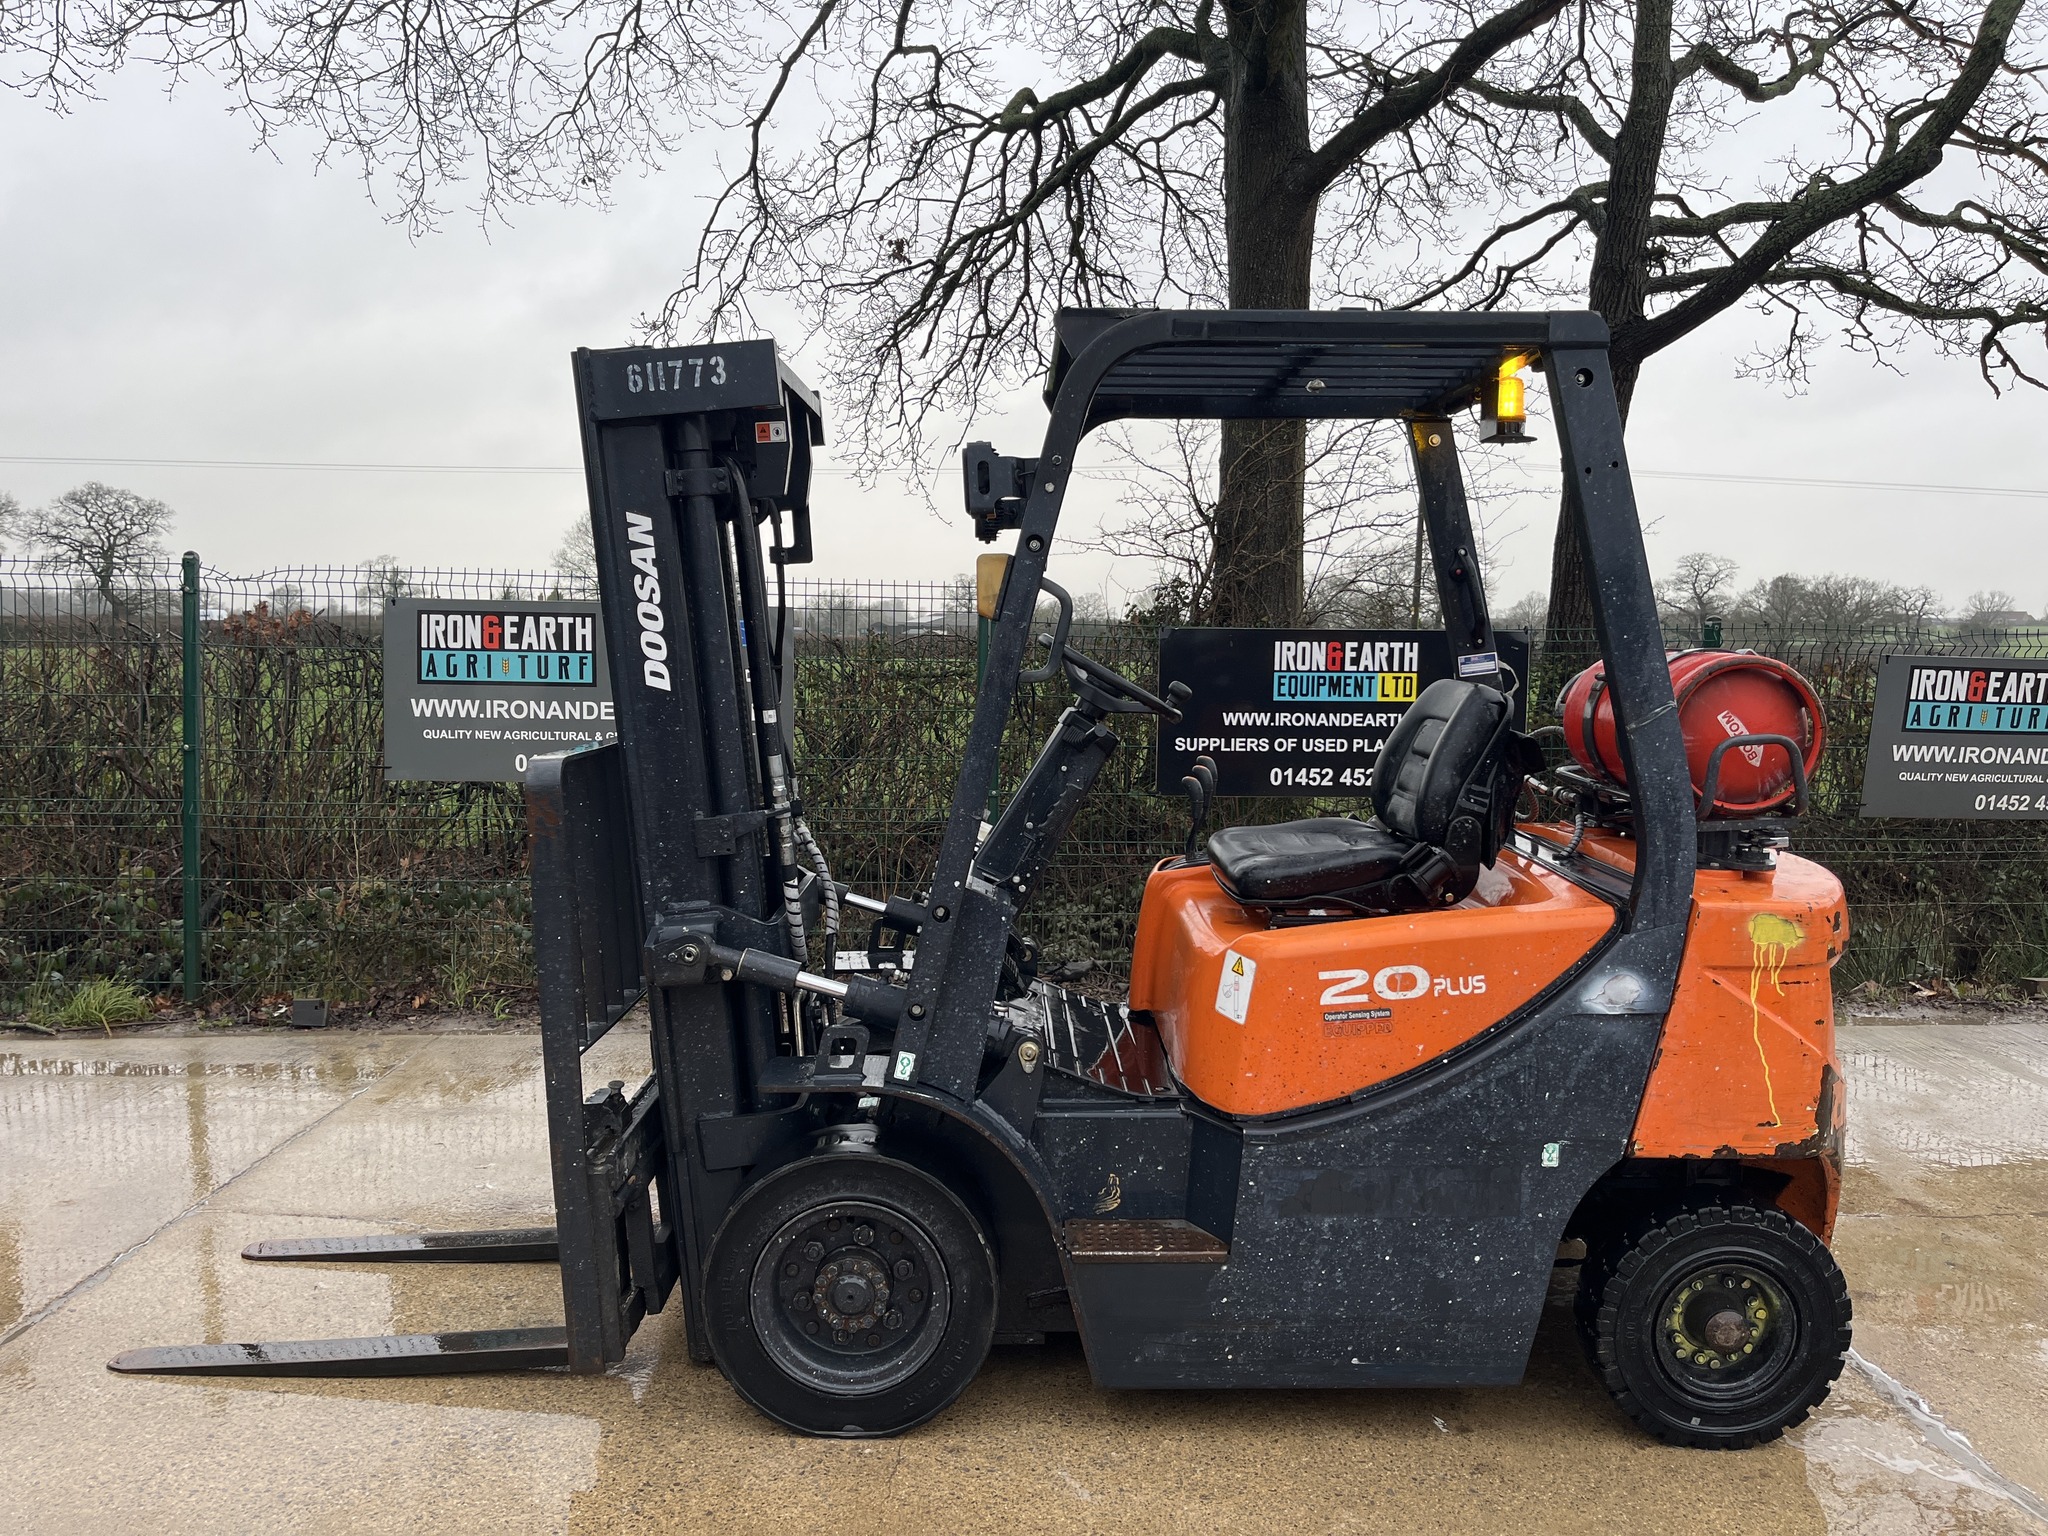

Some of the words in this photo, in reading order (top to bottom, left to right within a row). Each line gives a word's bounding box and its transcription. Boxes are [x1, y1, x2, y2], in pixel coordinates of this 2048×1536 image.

[626, 356, 726, 393] 611773
[626, 511, 671, 692] DOOSAN
[425, 654, 492, 678] AGRI
[517, 655, 588, 680] TURF
[1276, 675, 1375, 699] EQUIPMENT
[1380, 676, 1413, 698] LTD
[1910, 669, 2048, 703] IRON&EART
[410, 698, 615, 720] WWW.IRONANDE
[1909, 704, 1974, 728] AGRI
[1995, 707, 2048, 730] TUR
[423, 729, 473, 740] QUALITY
[475, 730, 502, 740] NEW
[503, 731, 592, 741] AGRICULTURAL
[594, 732, 603, 741] &
[1174, 738, 1270, 752] SUPPLIERS
[1273, 738, 1298, 752] OF
[1301, 738, 1348, 753] USED
[1269, 767, 1334, 787] 01452
[1898, 772, 1944, 782] QUALITY
[1945, 773, 1969, 783] NEW
[1970, 774, 2045, 784] AGRICULTURAL
[1974, 794, 2031, 811] 01452
[1317, 964, 1431, 1006] 20
[1433, 974, 1487, 997] PLUS
[1324, 1013, 1348, 1021] Operator
[1348, 1011, 1370, 1019] Sensing
[1370, 1010, 1391, 1019] System
